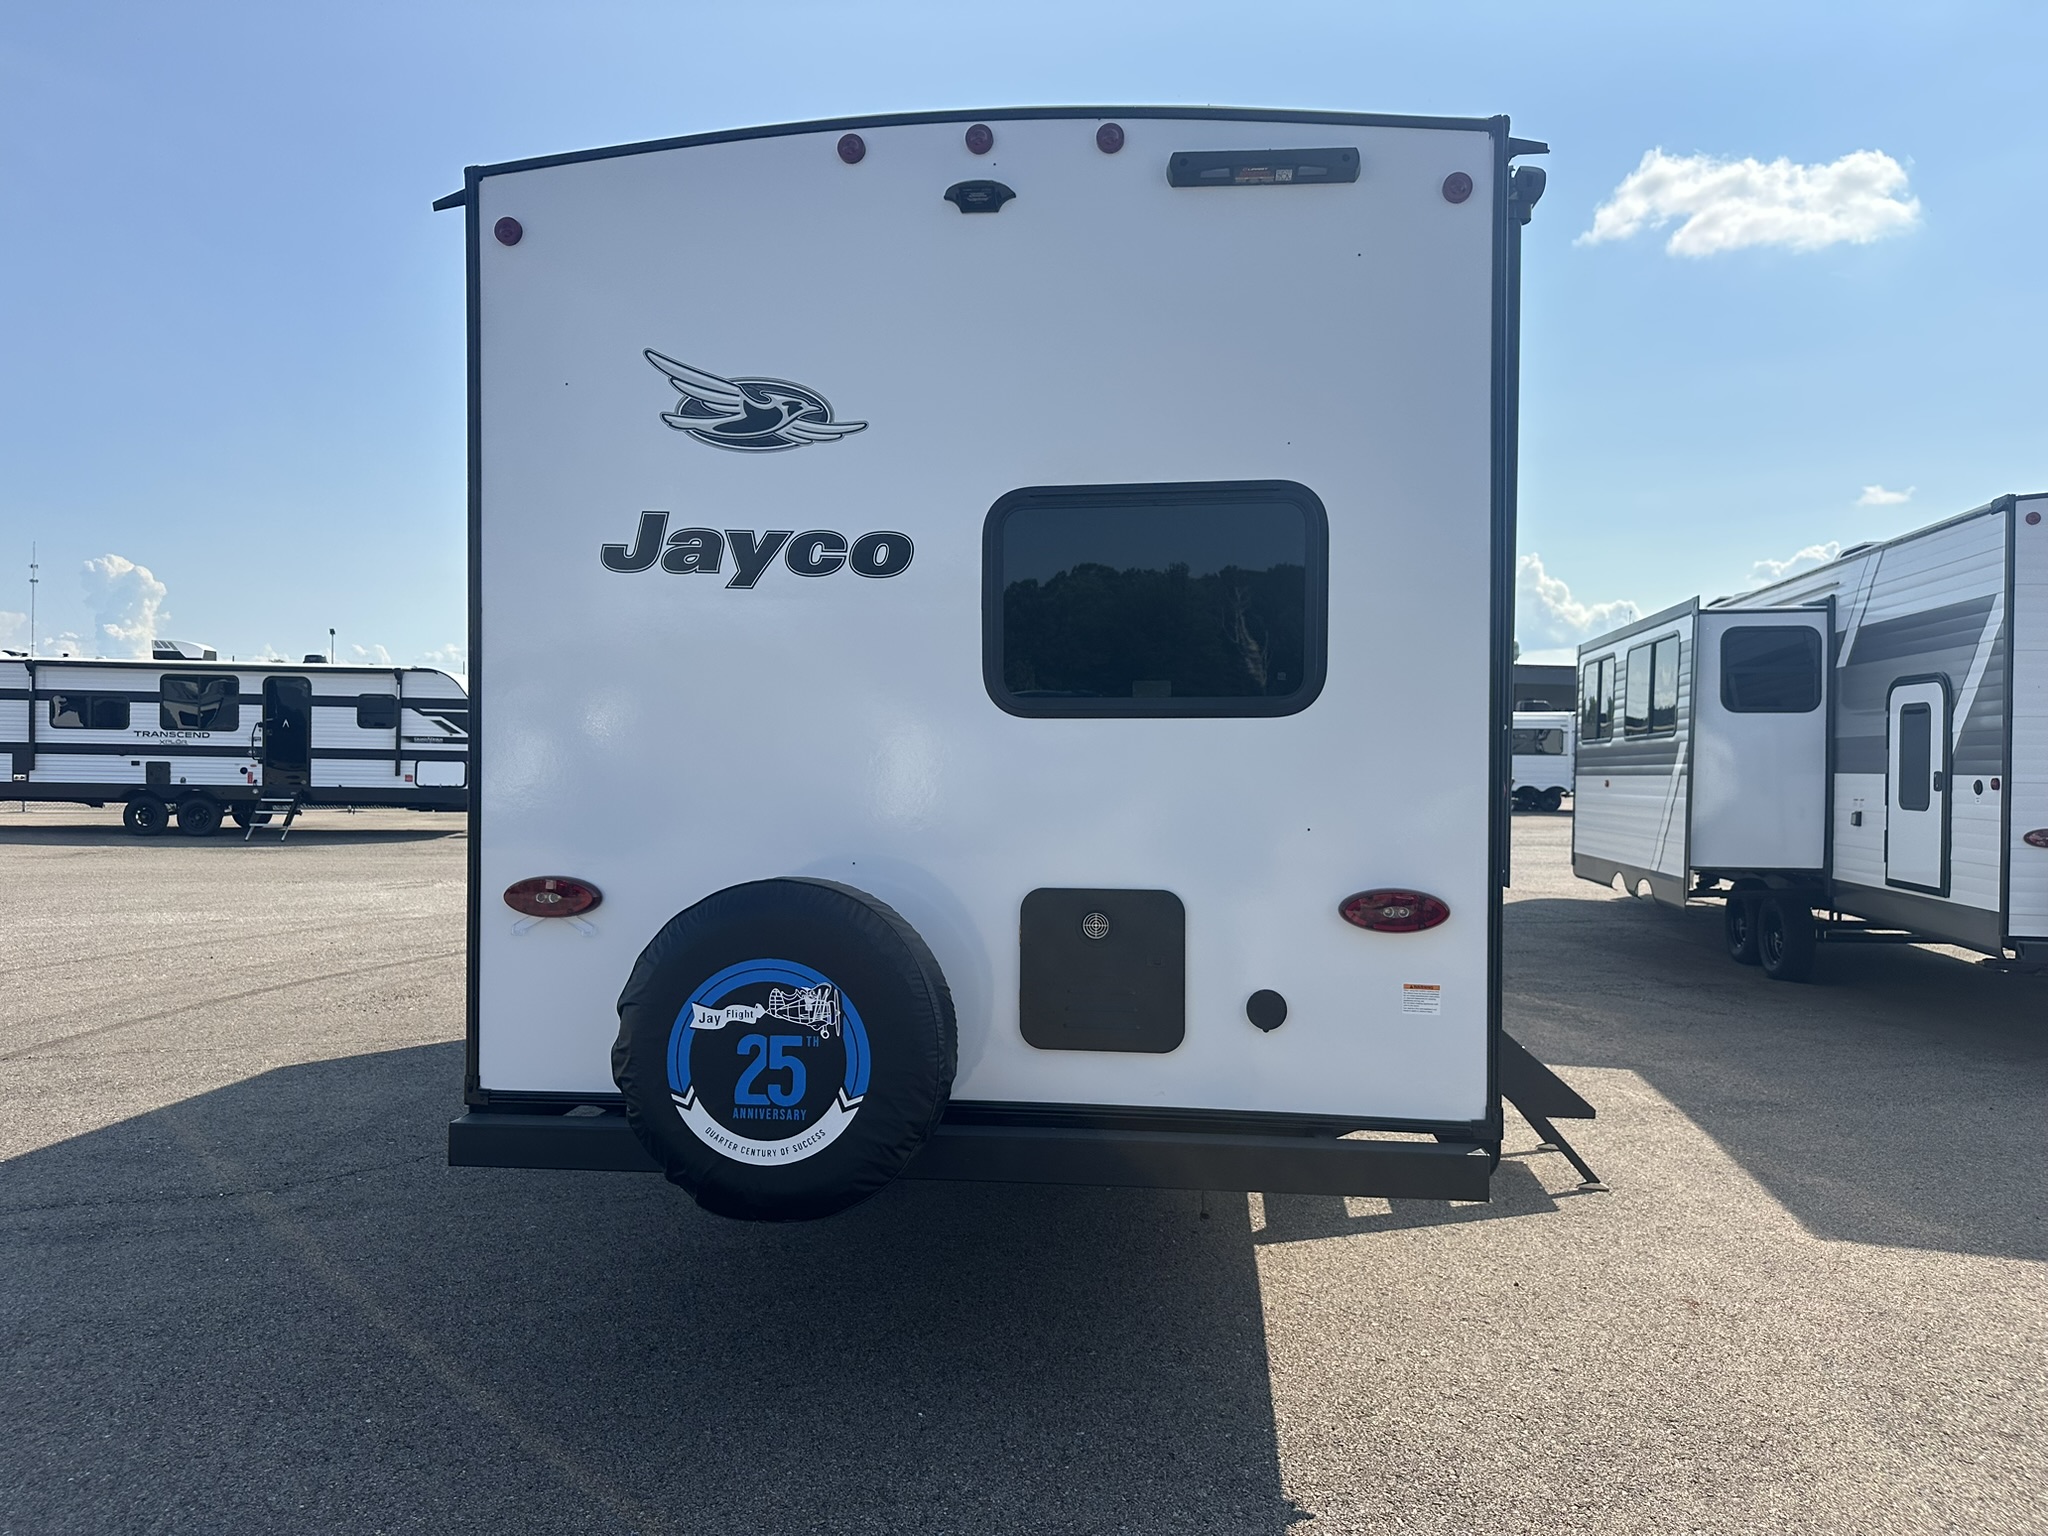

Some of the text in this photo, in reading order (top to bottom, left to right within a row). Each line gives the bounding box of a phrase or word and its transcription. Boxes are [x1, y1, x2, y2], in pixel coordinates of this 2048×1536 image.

[600, 510, 915, 590] Jayco
[133, 730, 211, 739] TRANSCEND
[698, 1009, 754, 1026] Jay Flight
[734, 1033, 820, 1107] 25 TH
[732, 1107, 807, 1121] ANNIVERSARY
[704, 1126, 826, 1157] QUARTER CENTURY OF SUCCESS
